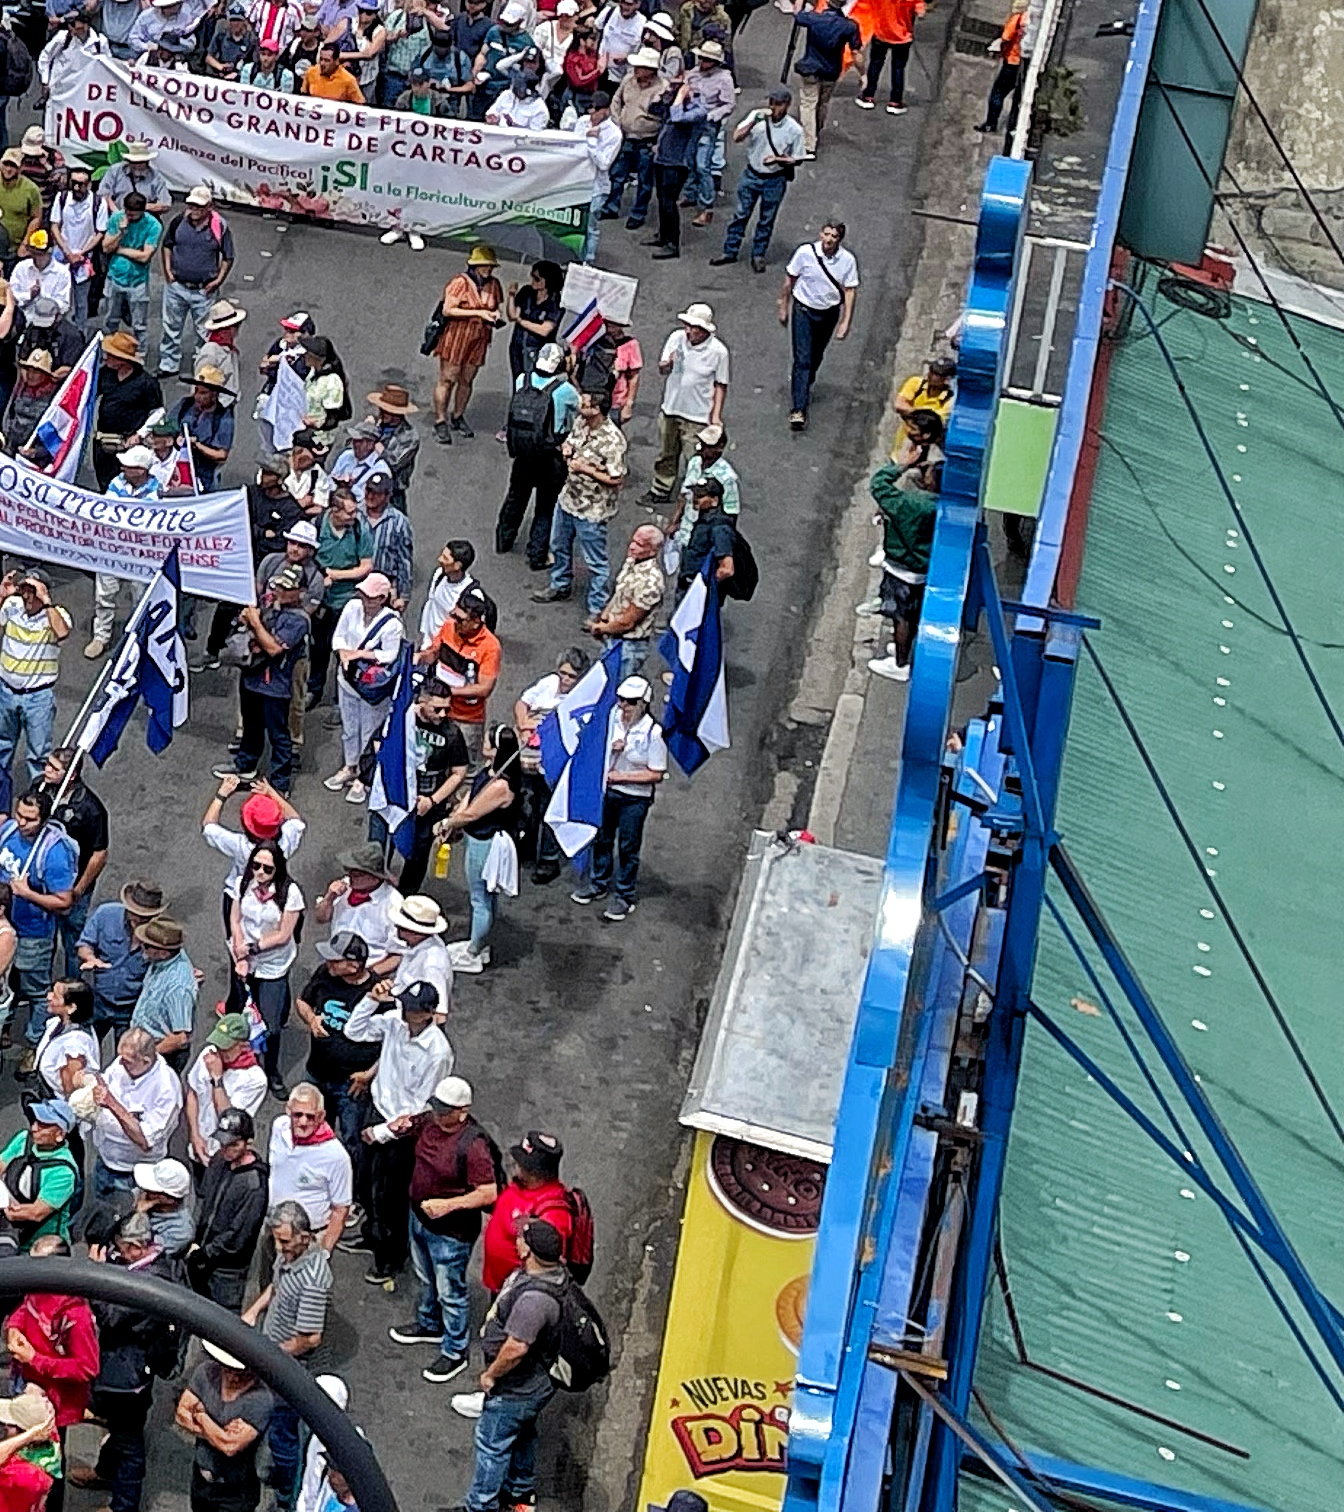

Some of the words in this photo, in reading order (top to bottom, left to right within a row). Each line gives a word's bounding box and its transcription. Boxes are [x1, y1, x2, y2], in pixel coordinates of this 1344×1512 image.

[55, 106, 124, 146] ¡NO
[158, 135, 216, 163] Alianza
[220, 152, 244, 168] del
[87, 83, 118, 103] DE
[129, 89, 215, 125] LLANO
[226, 111, 336, 148] GRANDE
[346, 132, 380, 154] DE
[390, 139, 528, 175] CARTAGO
[130, 70, 323, 121] PRODUCTORES
[335, 107, 368, 128] DE
[379, 114, 484, 145] FLORES
[373, 184, 383, 195] a
[386, 182, 403, 198] la
[405, 184, 498, 212] Floricultura
[680, 1376, 766, 1414] NUEVAS
